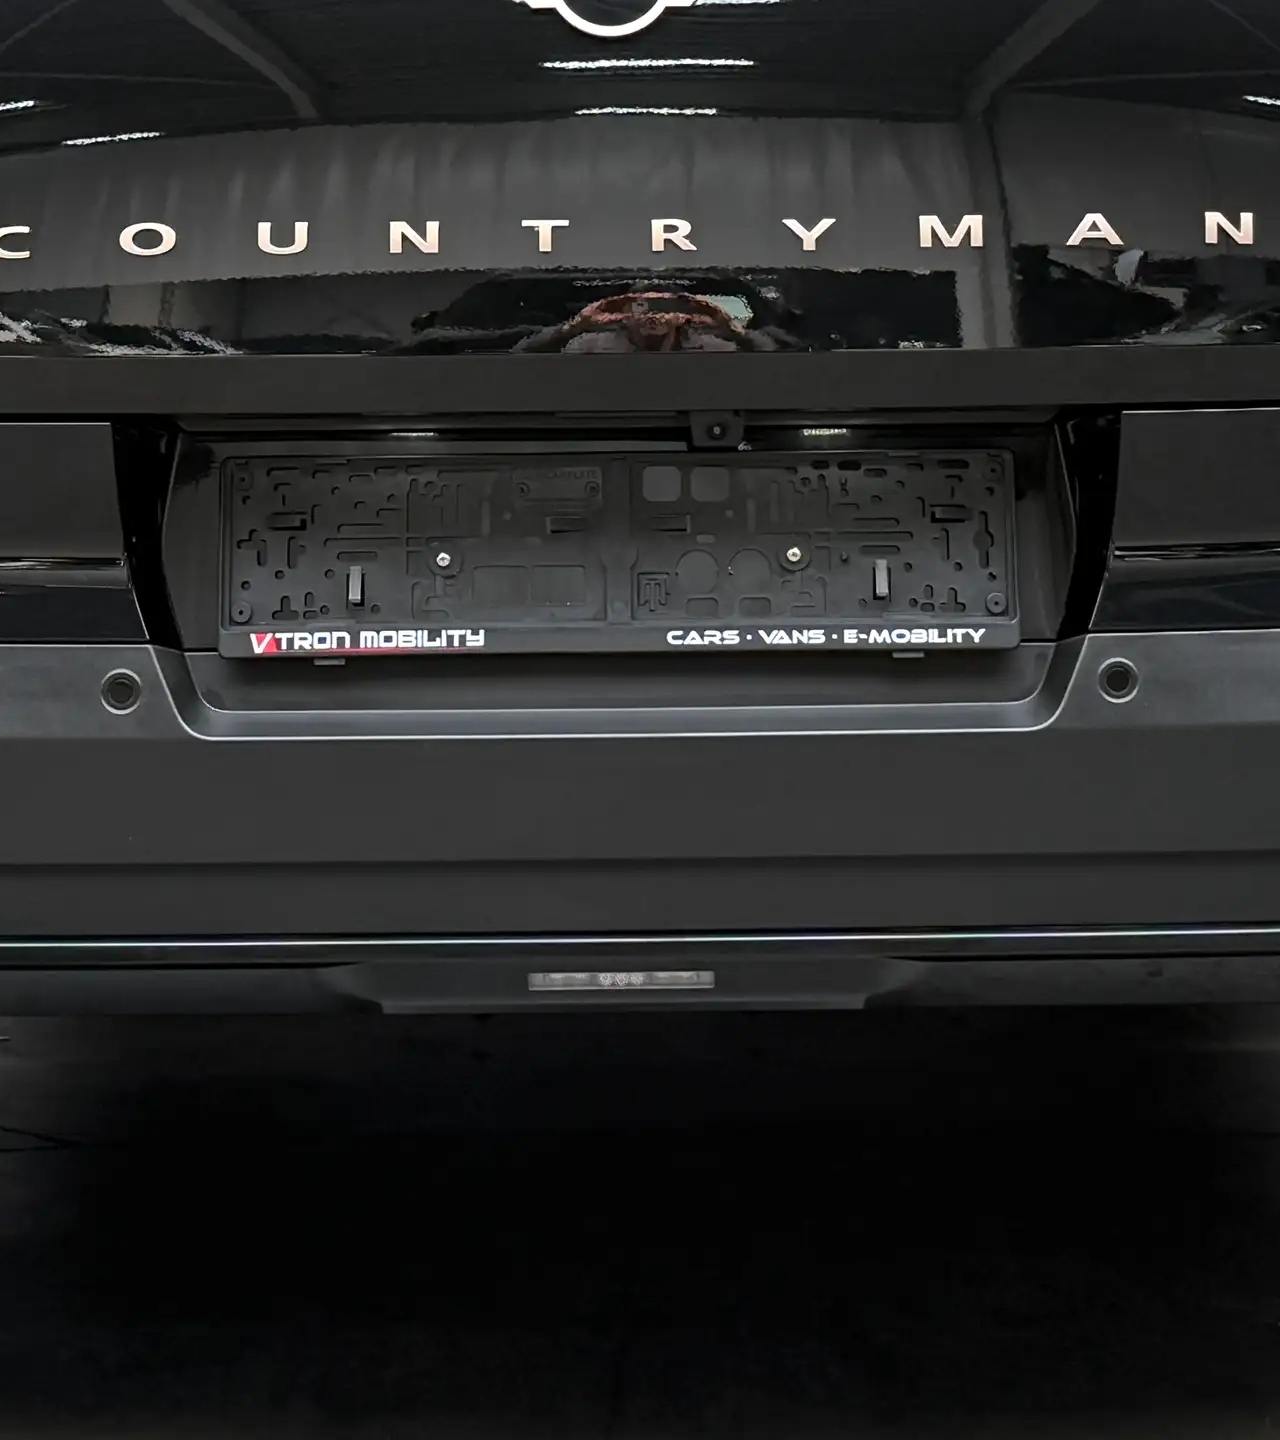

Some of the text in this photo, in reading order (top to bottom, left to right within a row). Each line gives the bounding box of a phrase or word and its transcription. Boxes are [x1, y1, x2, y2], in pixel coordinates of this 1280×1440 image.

[359, 628, 486, 649] MOBILITY
[665, 627, 987, 646] CARS VANS E-MOBILITY
